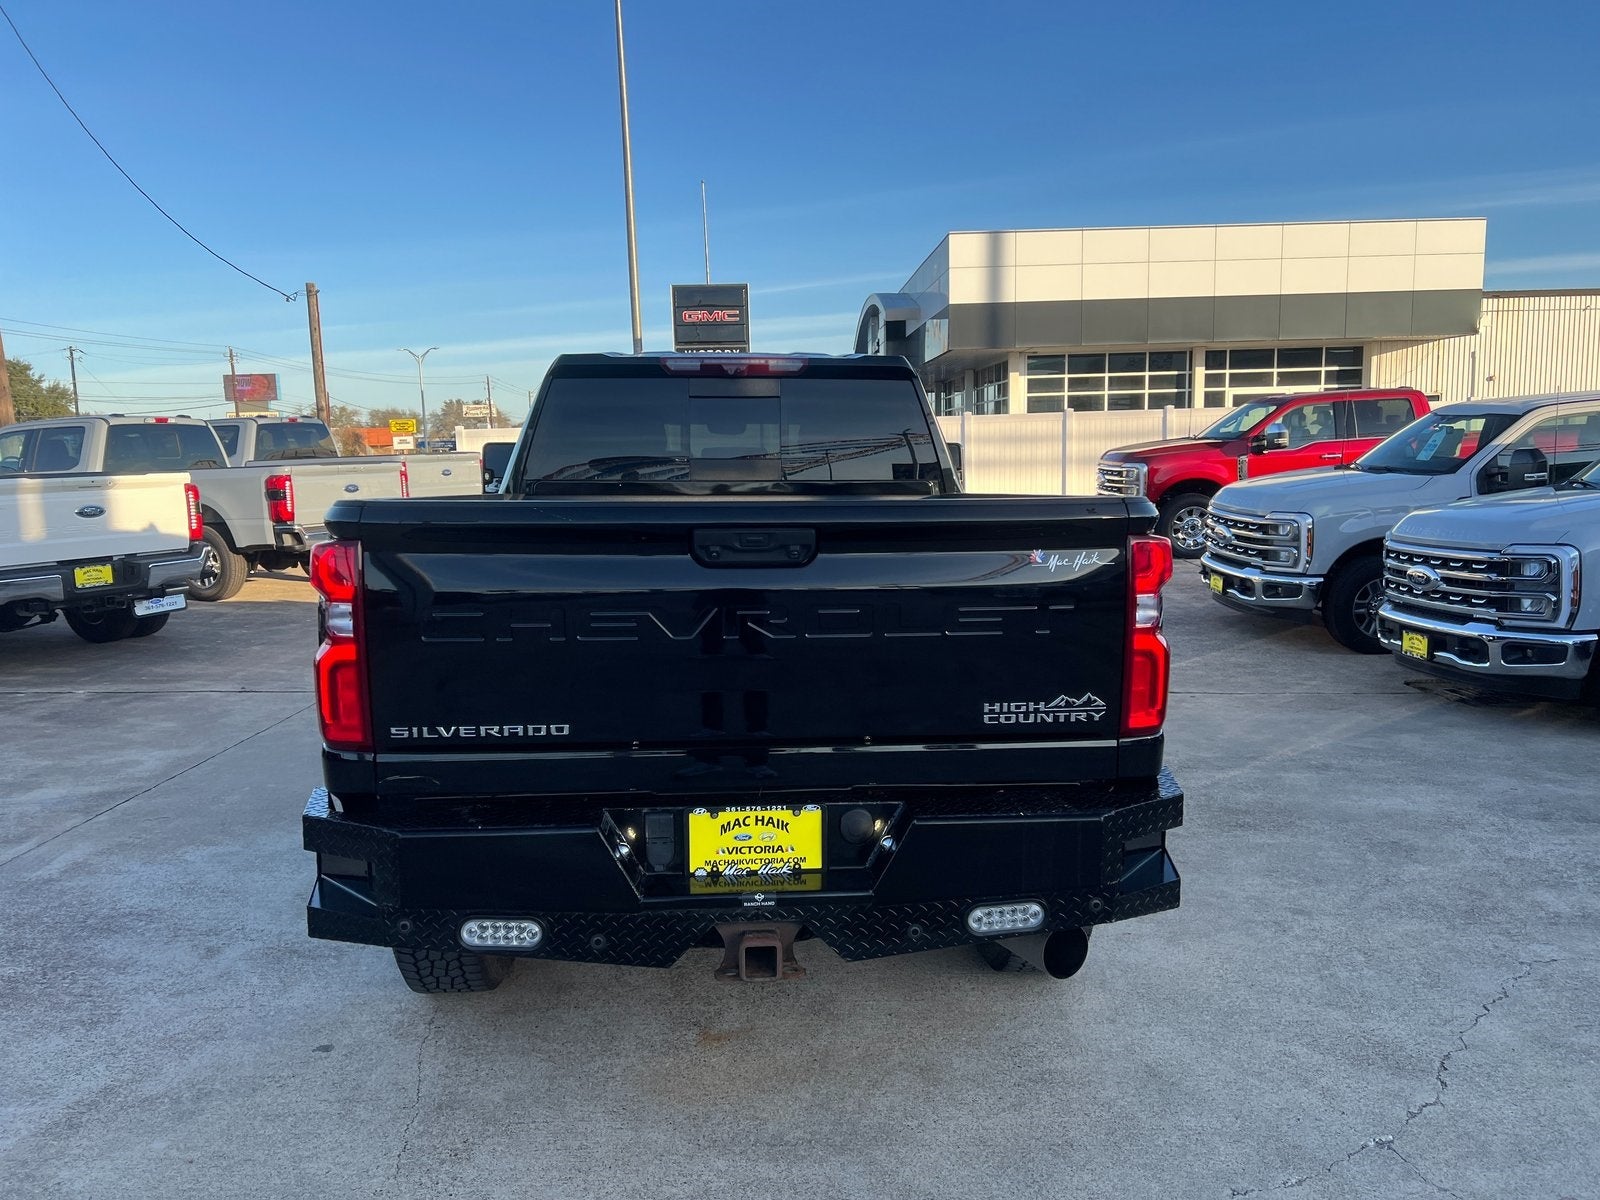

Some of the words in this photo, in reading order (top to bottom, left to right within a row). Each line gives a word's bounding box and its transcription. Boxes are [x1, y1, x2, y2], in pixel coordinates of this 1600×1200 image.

[682, 310, 739, 323] GMC
[1032, 555, 1073, 573] Mac
[1072, 551, 1115, 572] Haik
[420, 605, 1075, 641] CHEVROLET
[983, 701, 1045, 712] HIGH
[983, 711, 1106, 724] COUNTRY
[390, 724, 570, 738] SILVERADO
[720, 815, 751, 836] MAC
[755, 815, 790, 833] HAIK
[726, 845, 785, 855] VICTORIA
